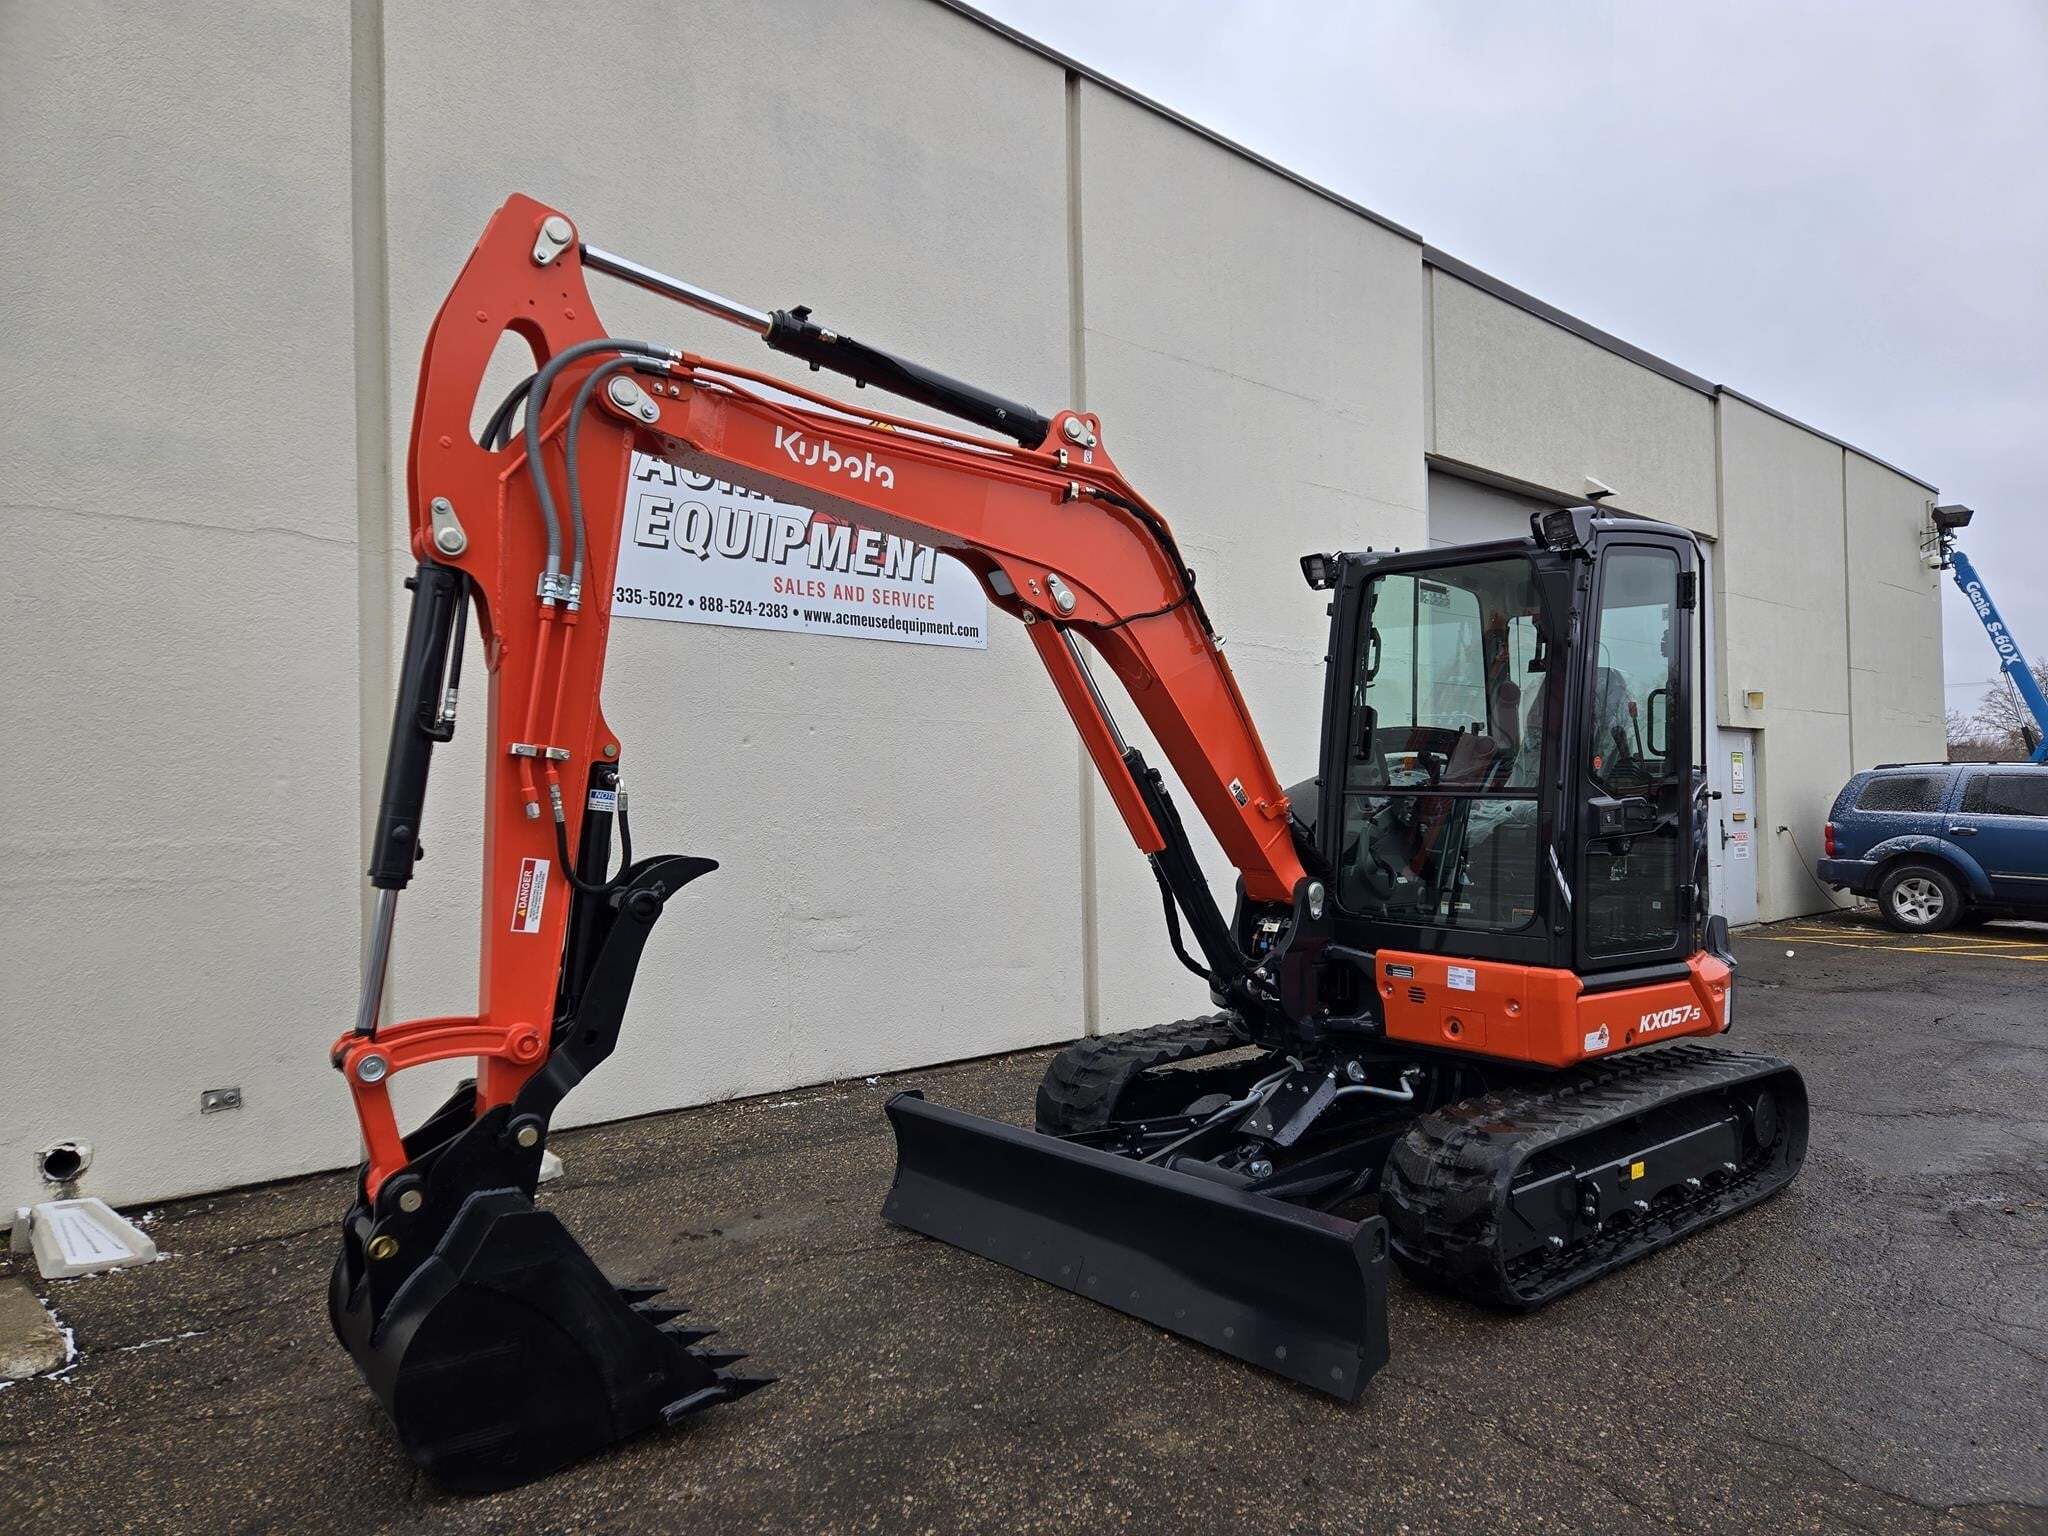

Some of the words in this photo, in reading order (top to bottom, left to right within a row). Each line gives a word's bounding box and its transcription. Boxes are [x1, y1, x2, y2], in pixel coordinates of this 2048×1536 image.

[775, 425, 894, 489] Kubota
[633, 494, 937, 585] EQUIPMENT
[773, 576, 826, 598] SALES
[833, 584, 865, 602] AND
[872, 588, 935, 610] SERVICE
[700, 596, 788, 619] 888-524-2383
[804, 609, 979, 638] www.acmeusedequipment.com
[1966, 581, 1991, 619] Genie
[1986, 621, 2022, 665] S-60X
[518, 870, 533, 909] DANGER
[1639, 1005, 1701, 1033] KX057-5
